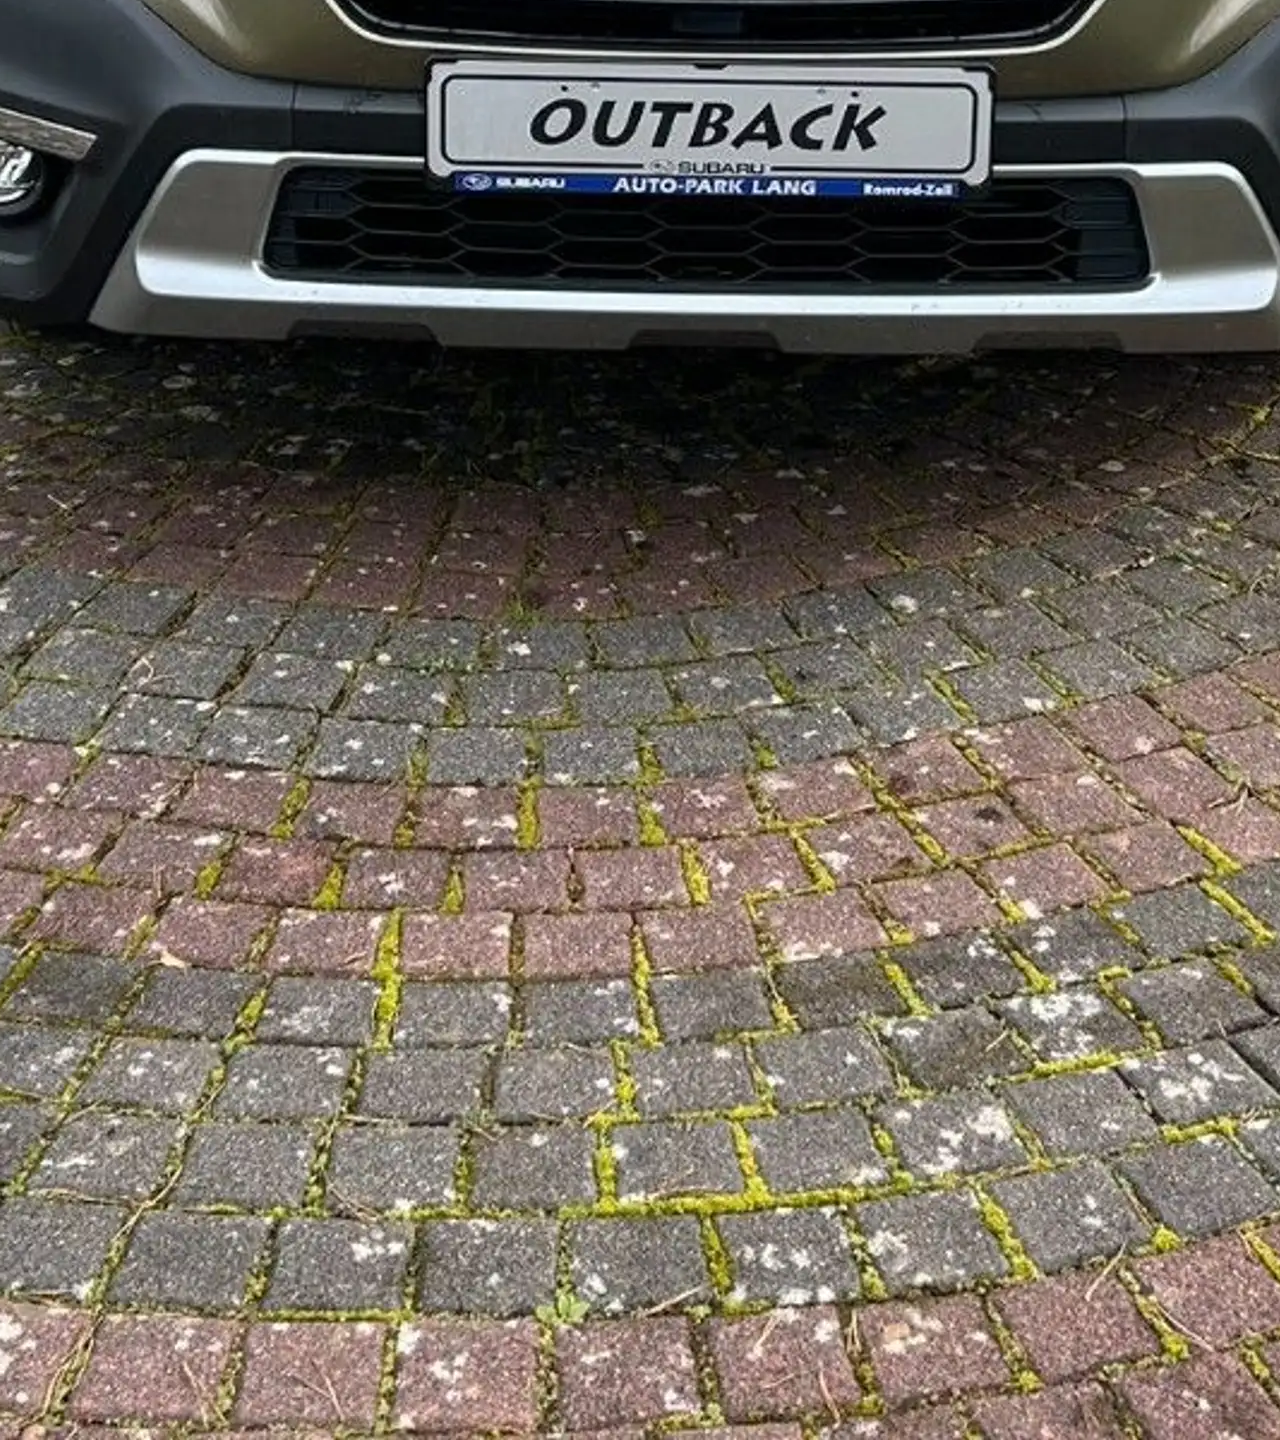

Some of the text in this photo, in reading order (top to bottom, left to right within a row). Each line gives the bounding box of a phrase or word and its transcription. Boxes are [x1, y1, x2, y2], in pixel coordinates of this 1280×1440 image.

[529, 97, 887, 151] OUTBACK
[677, 162, 765, 175] SUBARU
[495, 178, 566, 189] SUBARU
[613, 177, 816, 195] AUTO-PARK LANG
